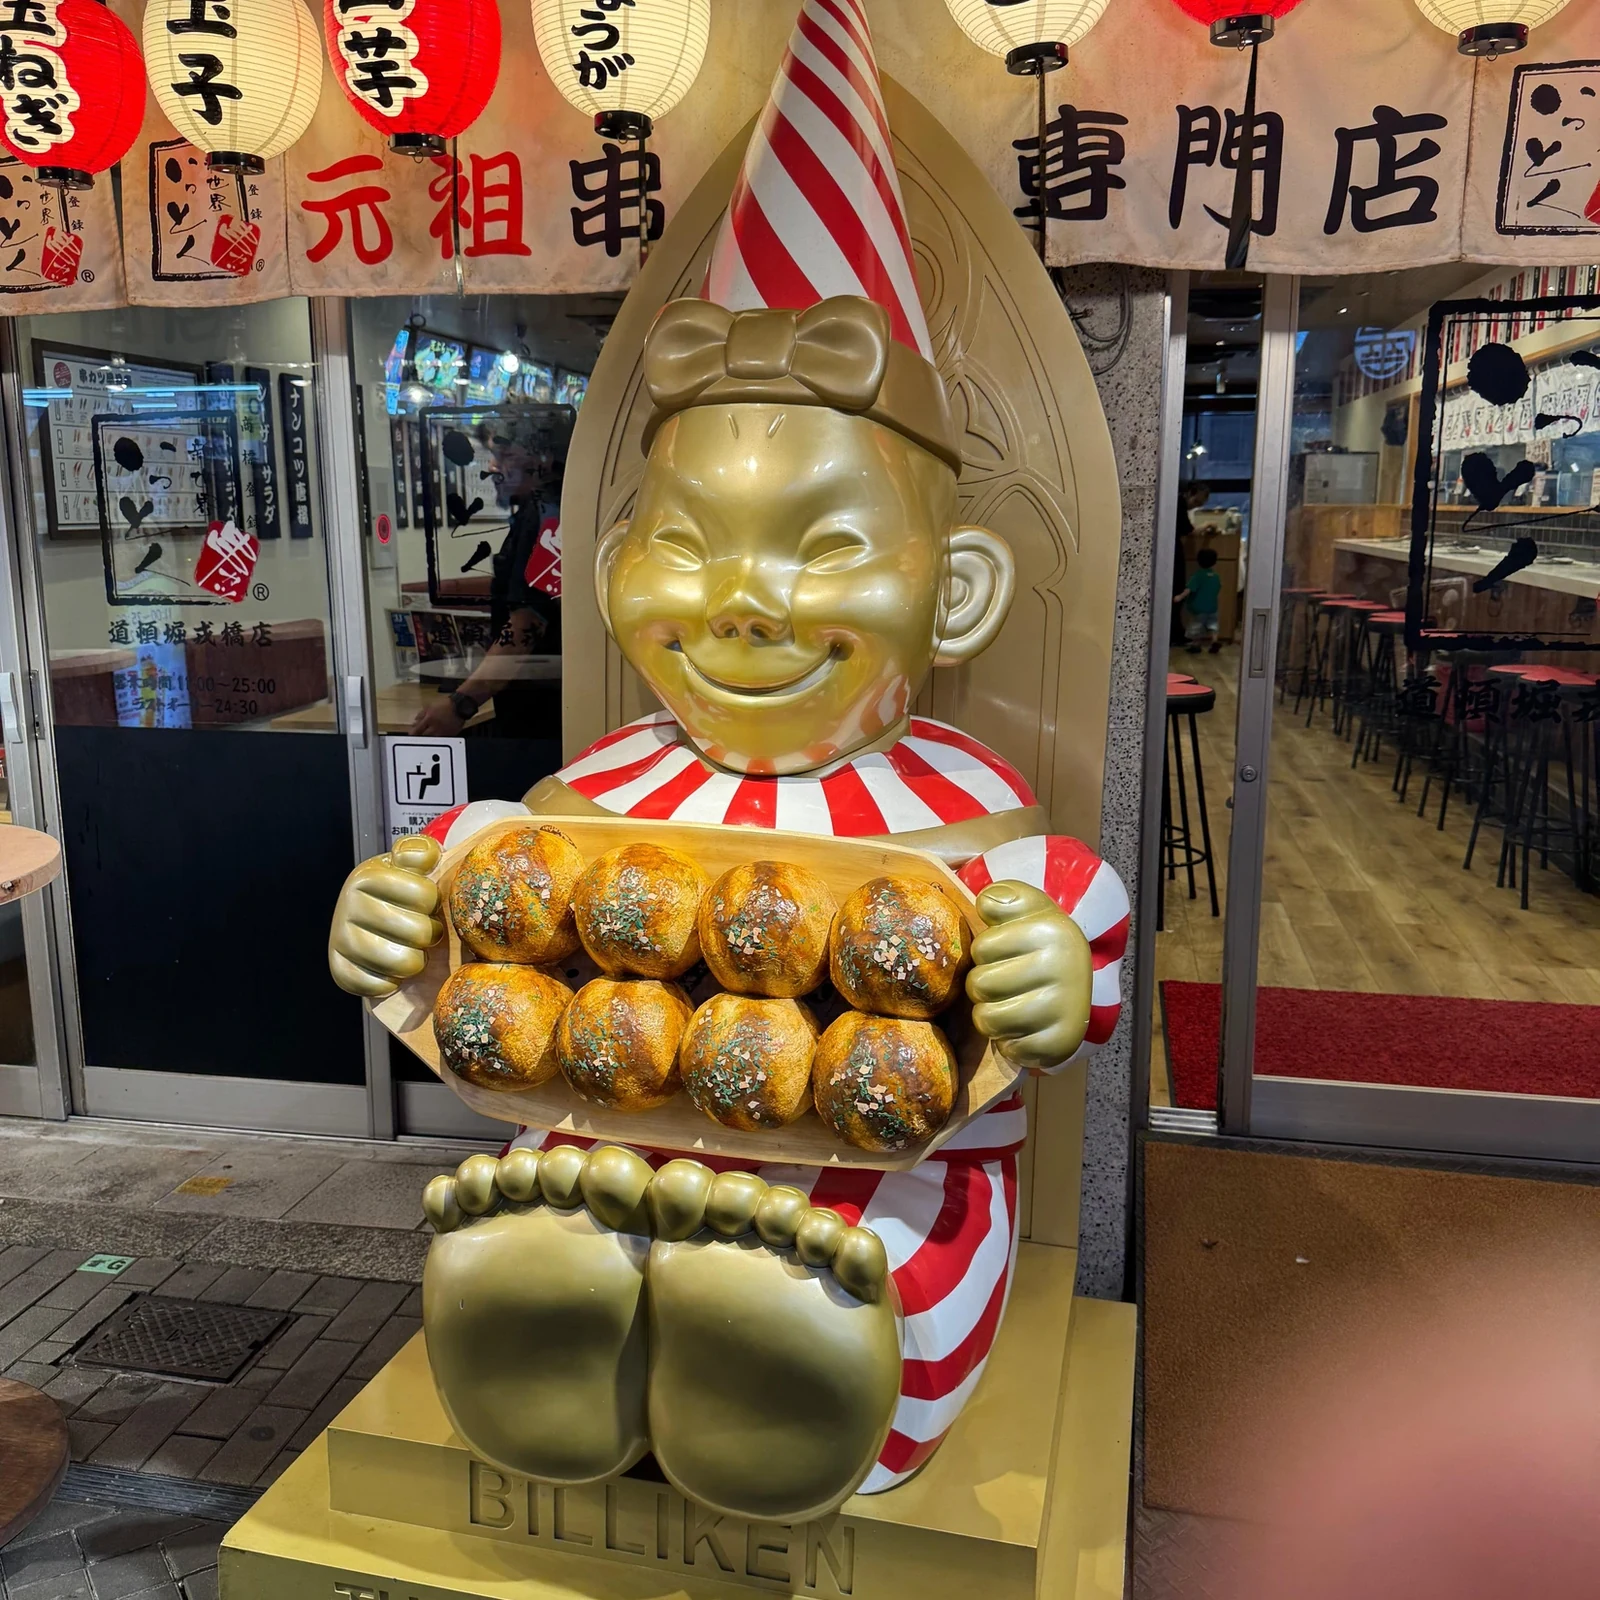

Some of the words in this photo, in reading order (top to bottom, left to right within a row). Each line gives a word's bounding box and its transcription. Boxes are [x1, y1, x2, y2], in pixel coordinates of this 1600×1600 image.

[338, 0, 417, 108] 芋
[108, 620, 273, 647] 道頓堀戎橋店
[469, 1460, 855, 1595] BILLIKEN
